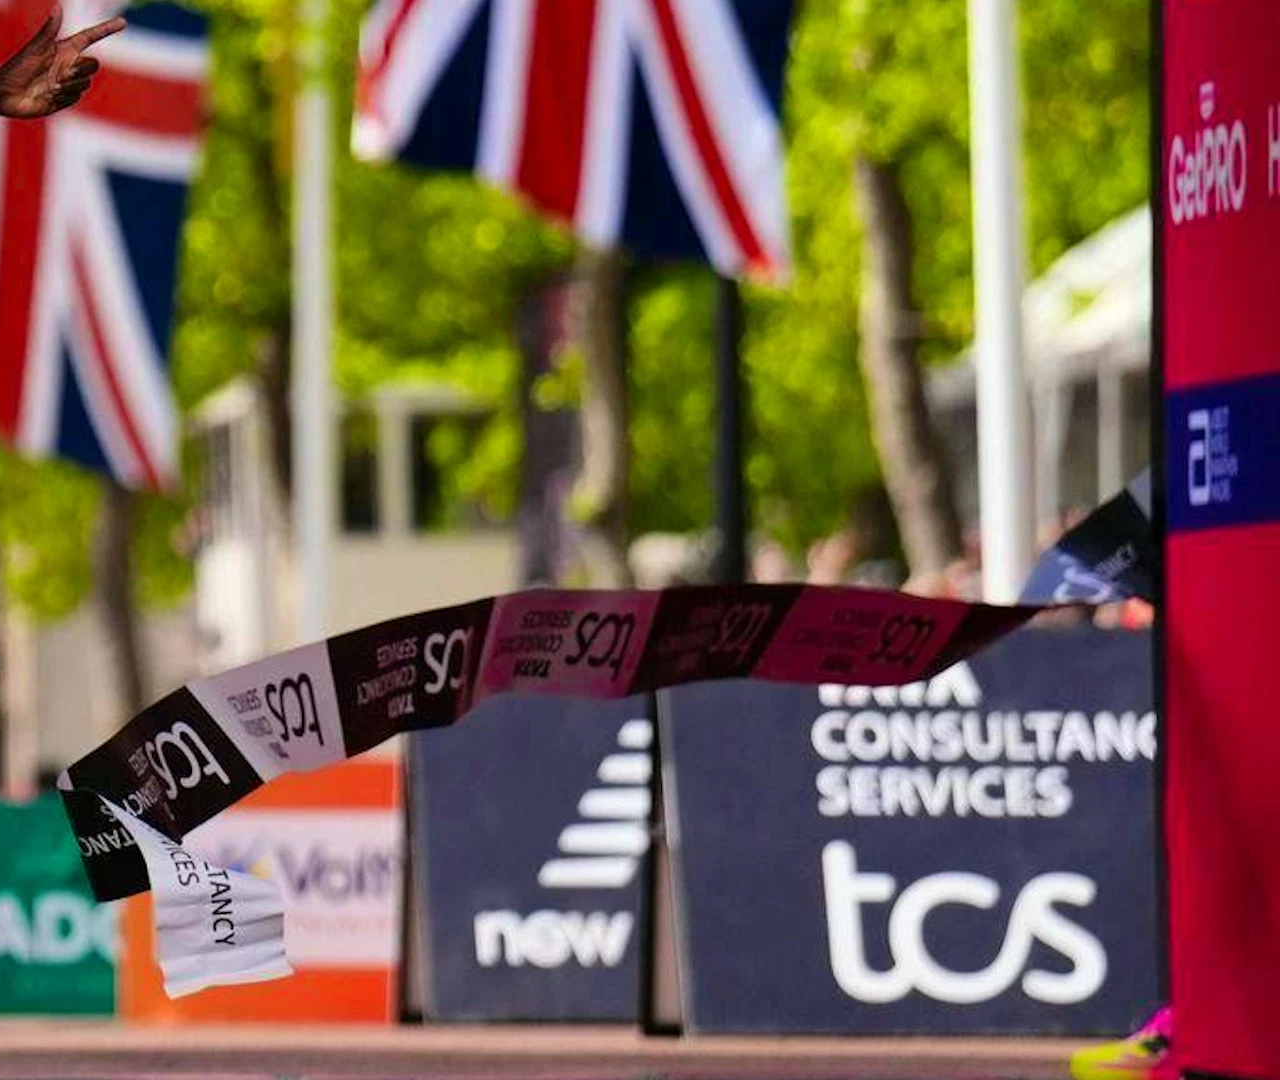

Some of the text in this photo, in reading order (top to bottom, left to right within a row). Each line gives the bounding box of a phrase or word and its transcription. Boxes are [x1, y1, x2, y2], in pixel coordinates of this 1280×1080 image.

[1168, 119, 1248, 226] GetPRO
[565, 611, 636, 682] tcs
[265, 672, 325, 747] tcs
[144, 721, 231, 801] tcs
[815, 766, 1074, 818] SERVICES
[473, 910, 634, 968] new
[822, 839, 1107, 1004] tcs
